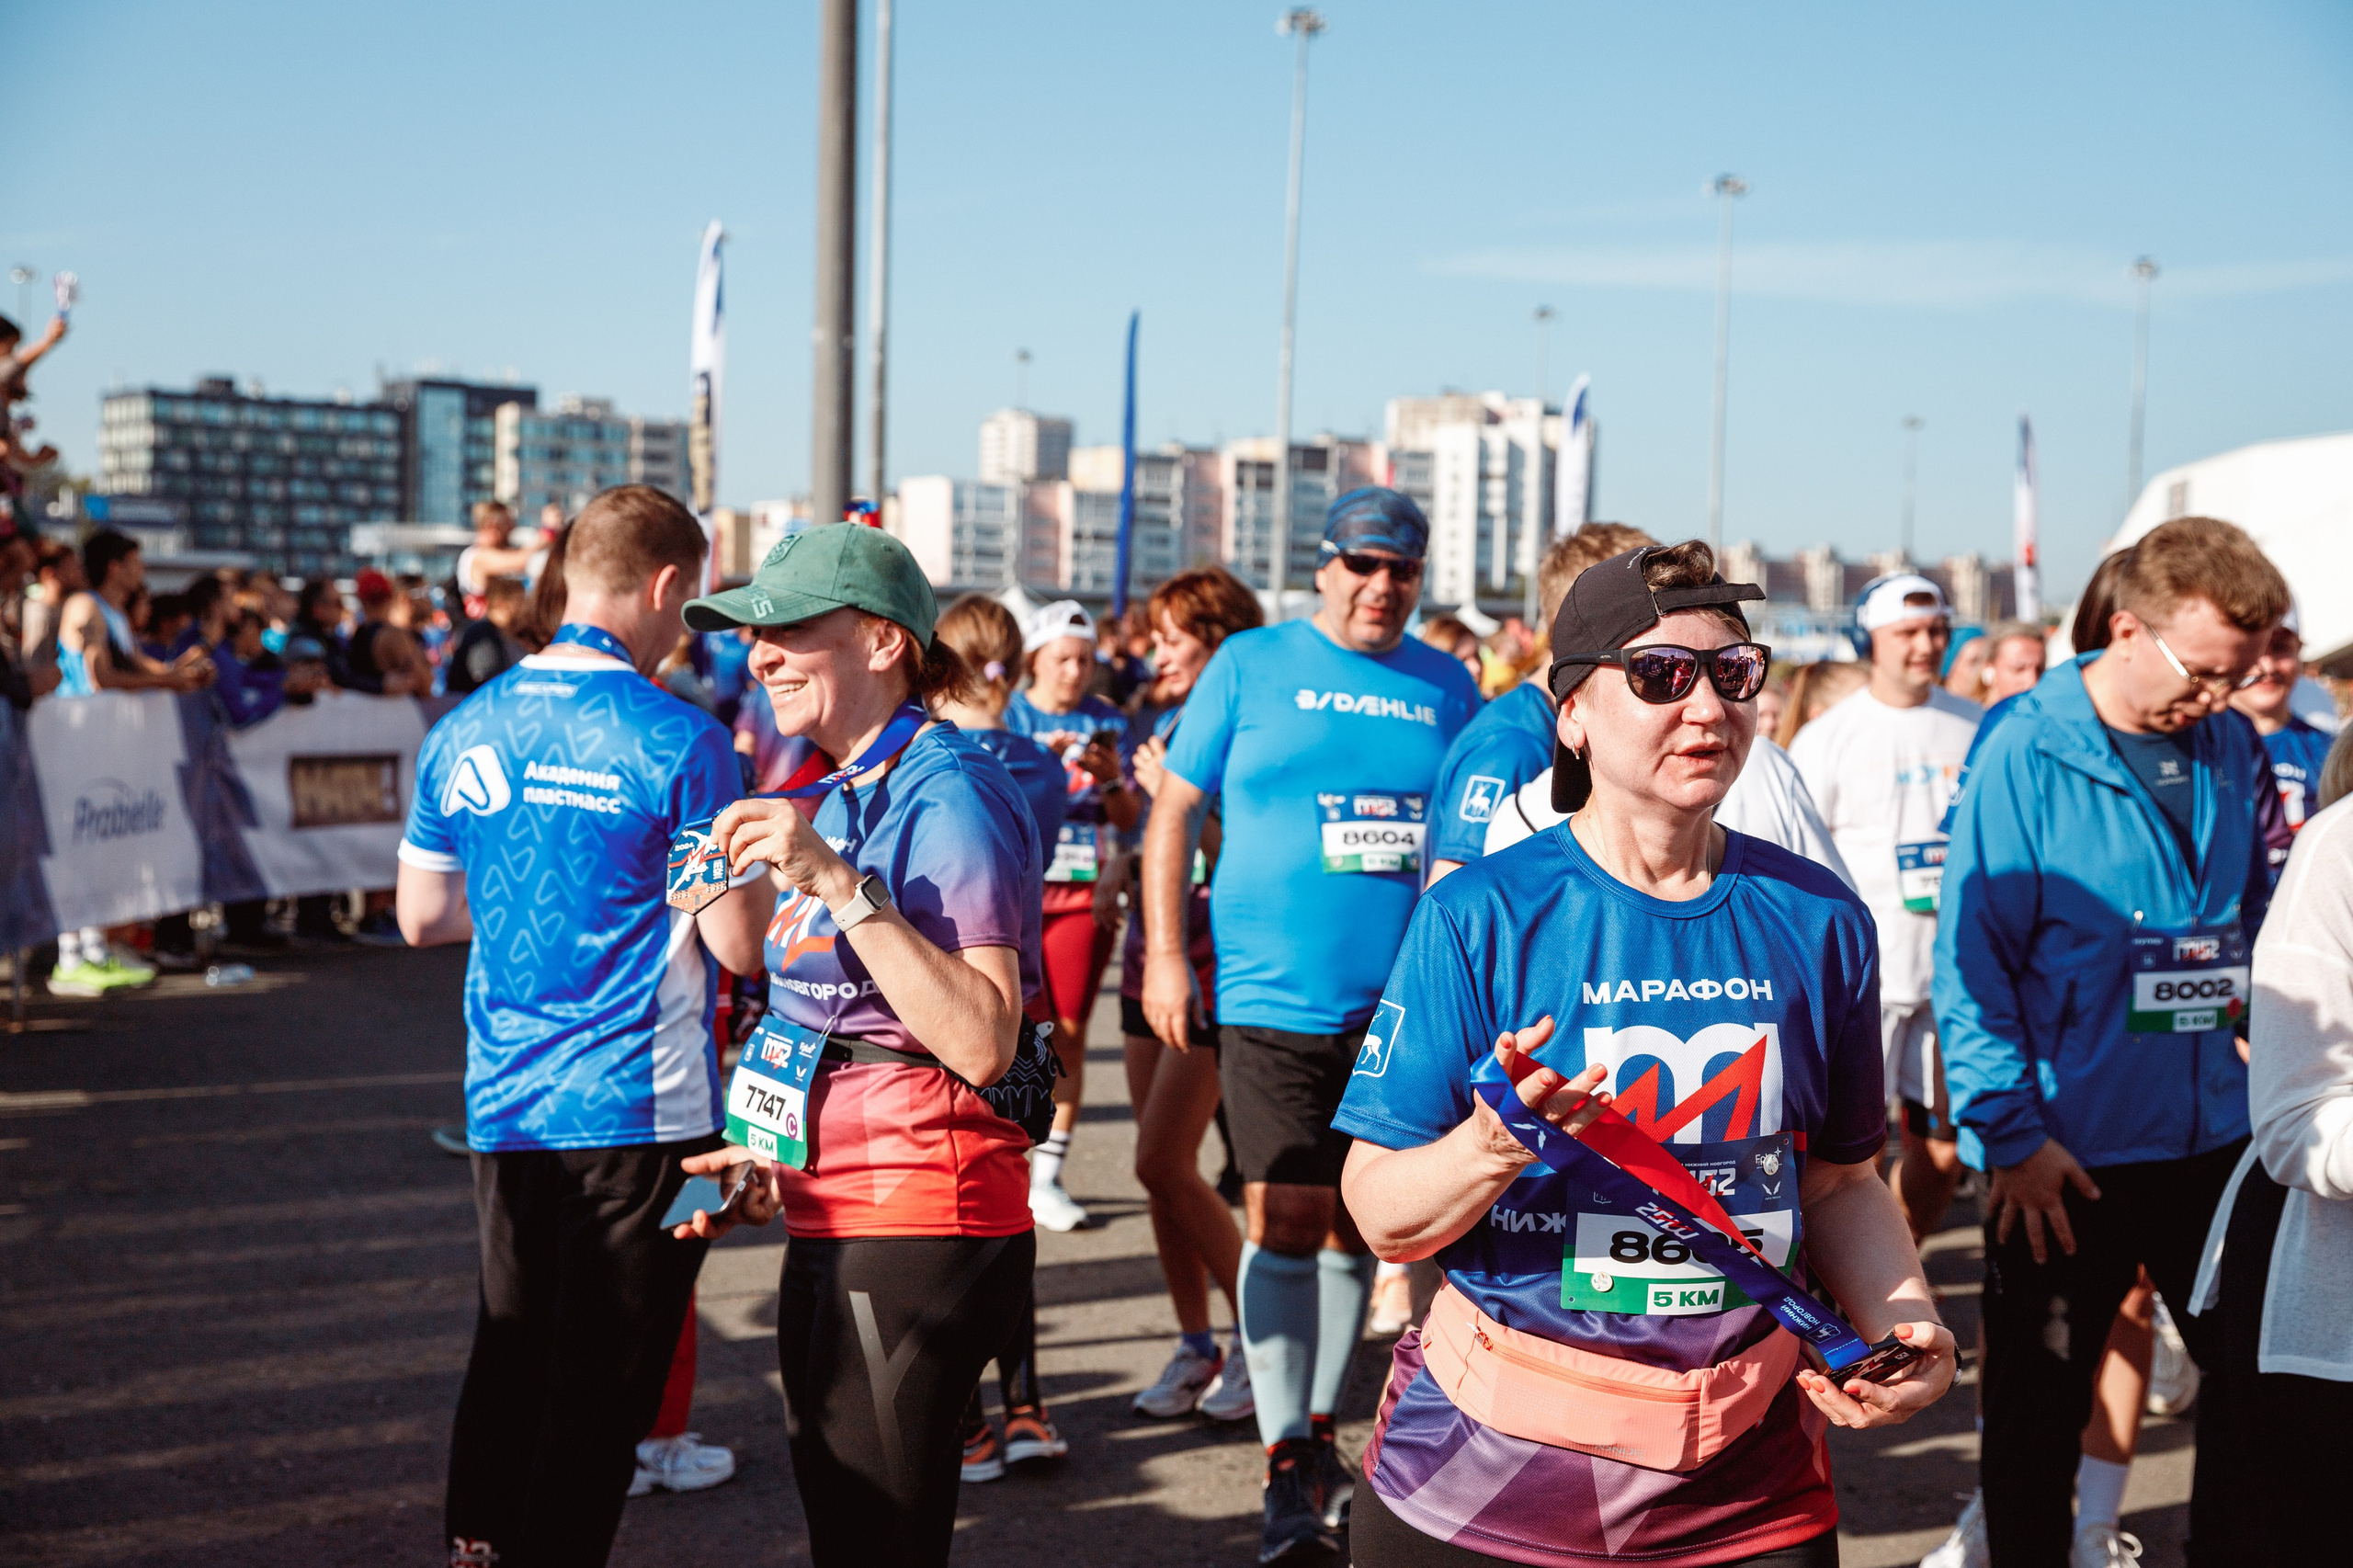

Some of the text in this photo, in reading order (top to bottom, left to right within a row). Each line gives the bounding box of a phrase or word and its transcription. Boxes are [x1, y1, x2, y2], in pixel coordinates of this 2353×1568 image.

[523, 760, 620, 791] Академия
[1343, 830, 1415, 846] 8604
[1583, 977, 1774, 1005] МАРАФОН
[2154, 978, 2235, 1001] 8002
[745, 1084, 786, 1120] 7747
[750, 1133, 774, 1153] 5 KM
[1653, 1289, 1720, 1308] 5 KM
[1783, 1296, 1821, 1326] НОВГОРОД
[1779, 1304, 1813, 1331] НИЖНИЙ
